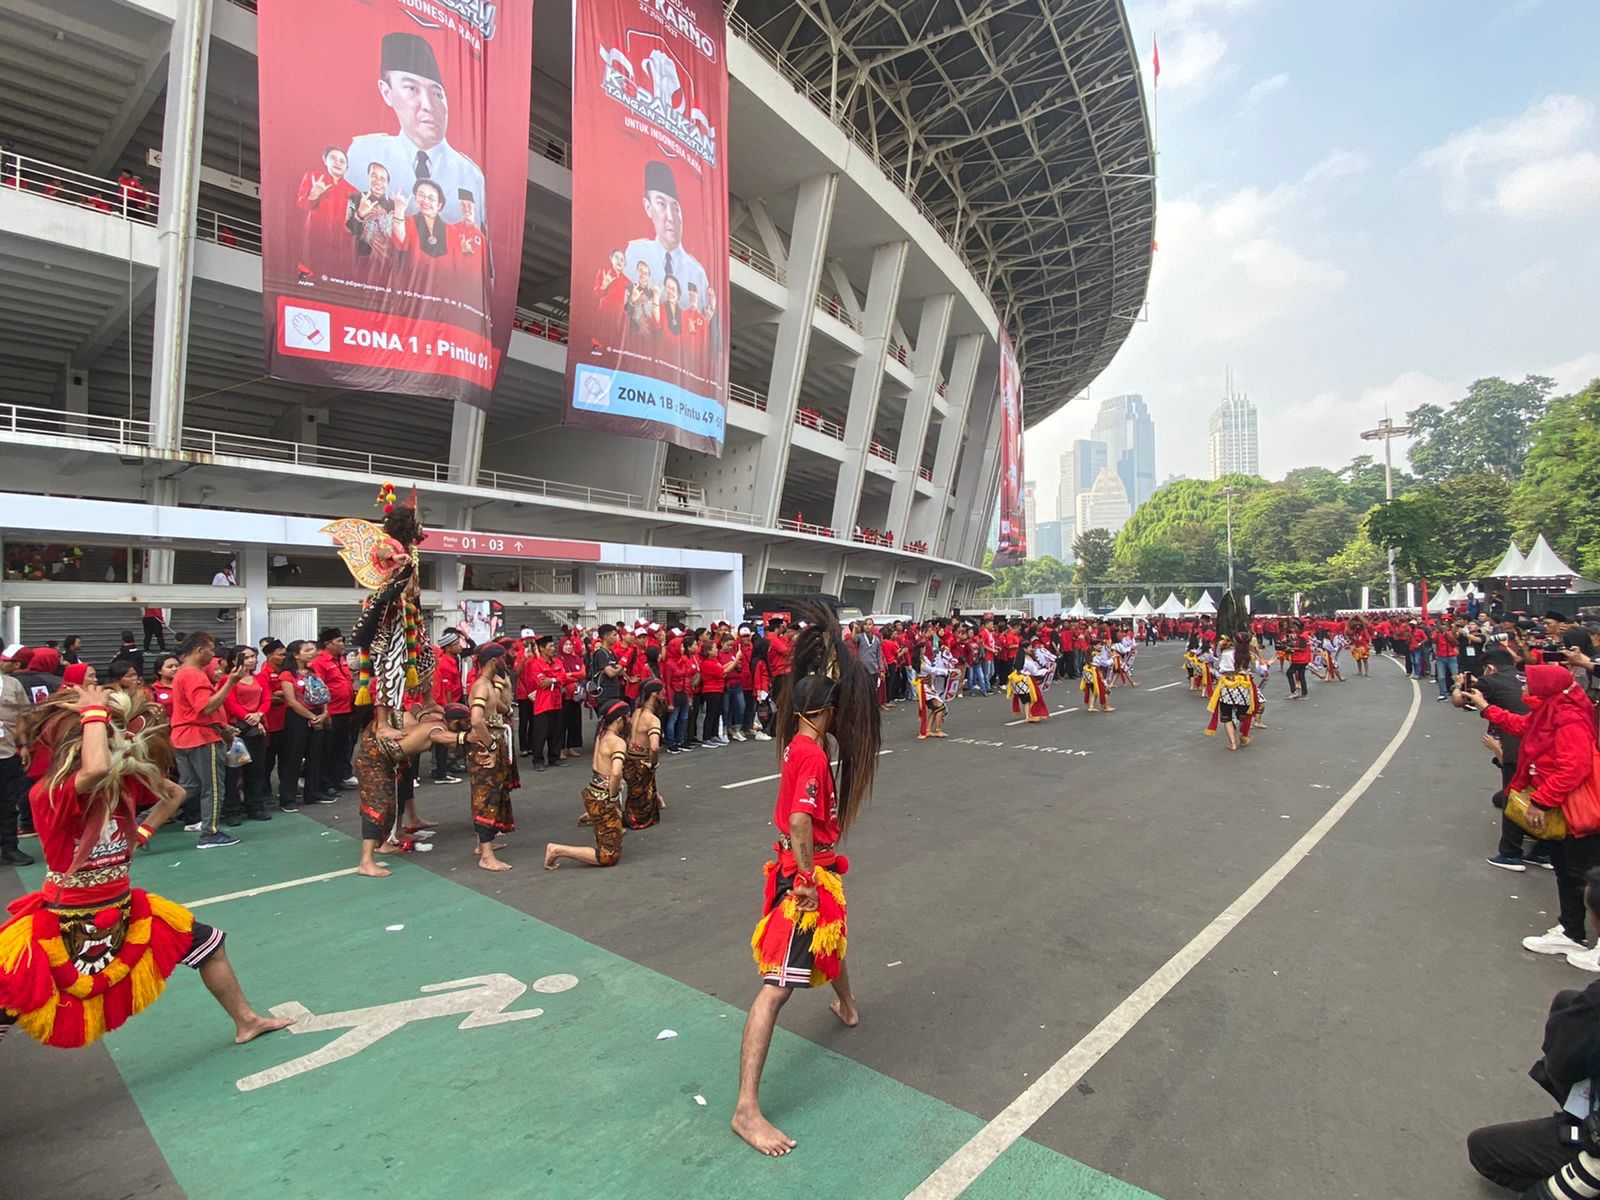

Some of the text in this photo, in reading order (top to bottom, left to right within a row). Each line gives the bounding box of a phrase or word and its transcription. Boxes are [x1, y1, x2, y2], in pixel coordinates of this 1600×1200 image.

[606, 85, 655, 121] TANGAN
[624, 116, 650, 135] UNTUK
[343, 326, 403, 352] ZONA
[408, 335, 418, 353] 1
[437, 339, 476, 365] Pintu
[478, 351, 488, 371] 01
[618, 386, 657, 407] ZONA
[660, 395, 674, 410] 1B
[679, 402, 701, 421] Pintu
[702, 411, 714, 424] 49
[462, 536, 477, 549] 01
[489, 538, 505, 551] 03
[1011, 743, 1094, 756] JARAK
